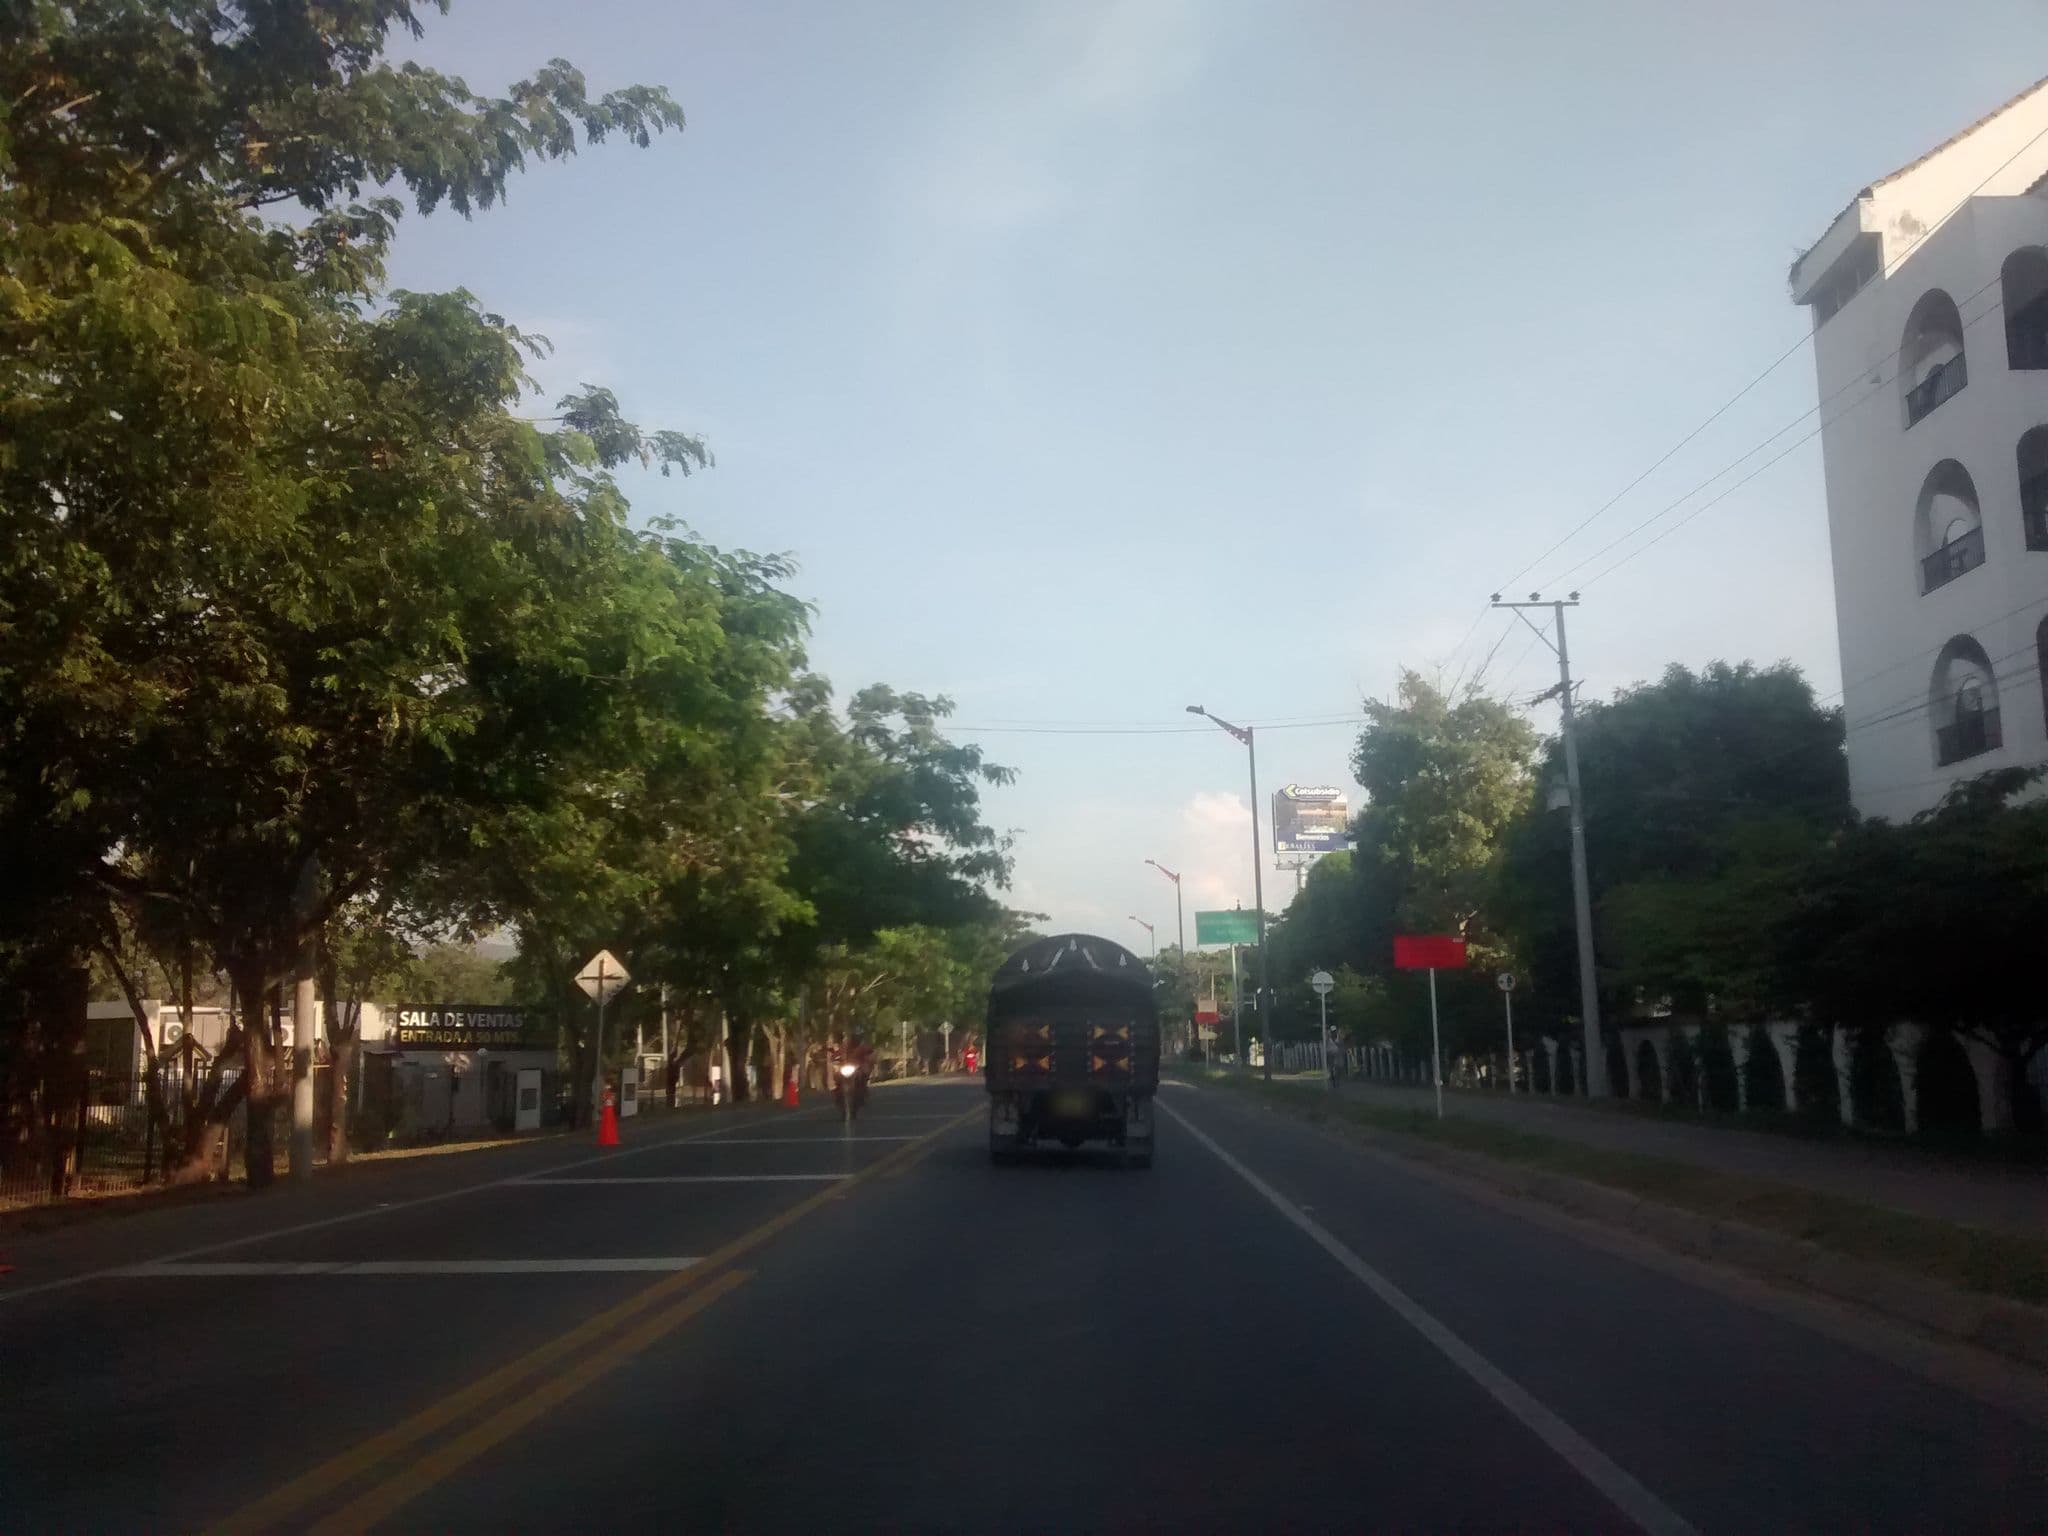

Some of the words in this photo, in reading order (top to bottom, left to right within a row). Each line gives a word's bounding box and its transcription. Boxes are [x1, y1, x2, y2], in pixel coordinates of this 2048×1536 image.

[399, 1011, 441, 1027] SALA
[444, 1012, 465, 1027] DE
[467, 1013, 523, 1028] VENTAS
[400, 1029, 462, 1044] ENTRADA
